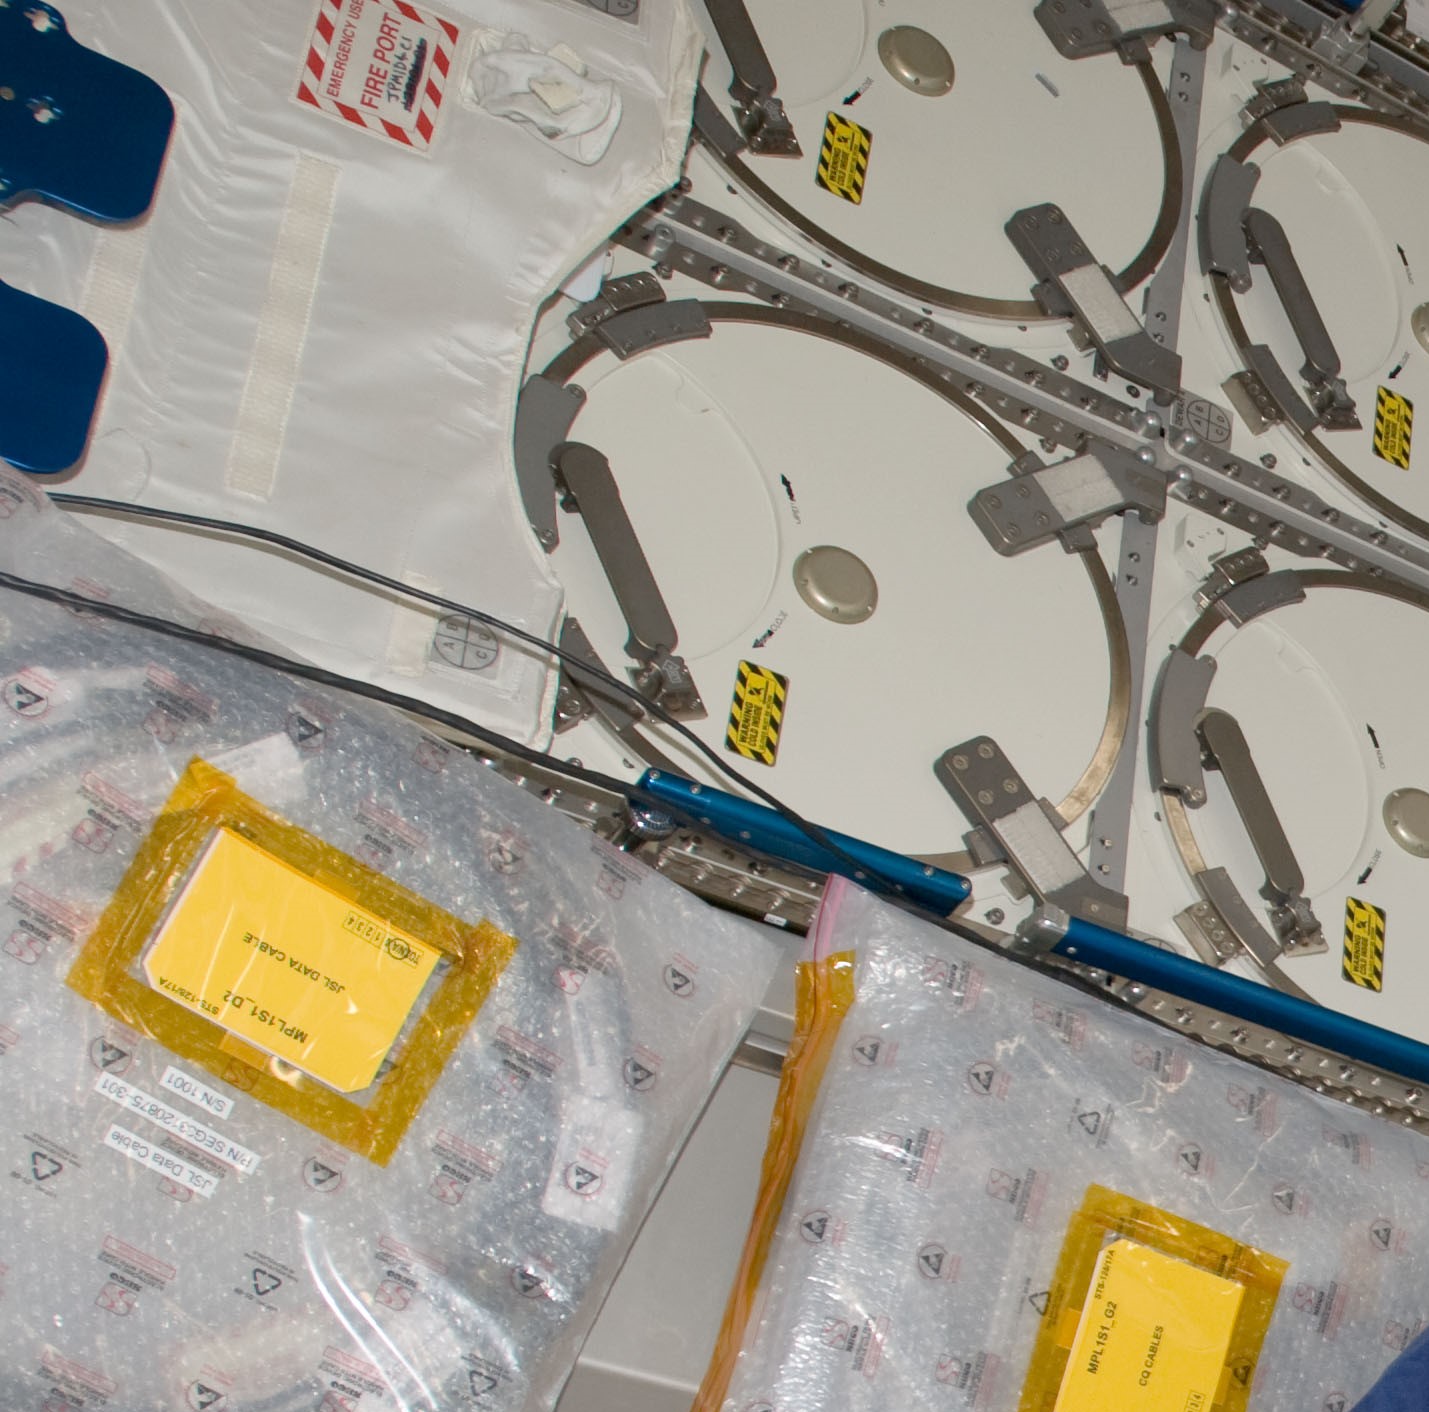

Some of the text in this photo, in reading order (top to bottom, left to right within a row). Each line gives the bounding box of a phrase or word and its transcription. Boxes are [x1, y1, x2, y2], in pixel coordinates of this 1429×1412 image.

[326, 0, 364, 97] EMERGENCY USE
[360, 12, 400, 109] FIRE PORT
[828, 147, 841, 181] WARNING
[739, 701, 756, 743] WARNING
[746, 704, 762, 747] COLD INSIDE
[243, 932, 345, 993] JSL DATA CABLE
[1356, 936, 1368, 975] COLD INSIDE
[159, 976, 219, 1015] STS-128/17A
[223, 990, 308, 1043] MPL1S1_D2
[167, 1073, 226, 1112] S/N 1001
[111, 1130, 212, 1189] JSL Data Cable
[226, 1146, 252, 1167] P/N
[1094, 1249, 1114, 1299] STS-128/17A
[1086, 1300, 1117, 1374] MPL1S1_G2
[1138, 1325, 1163, 1386] CQ CABLES
